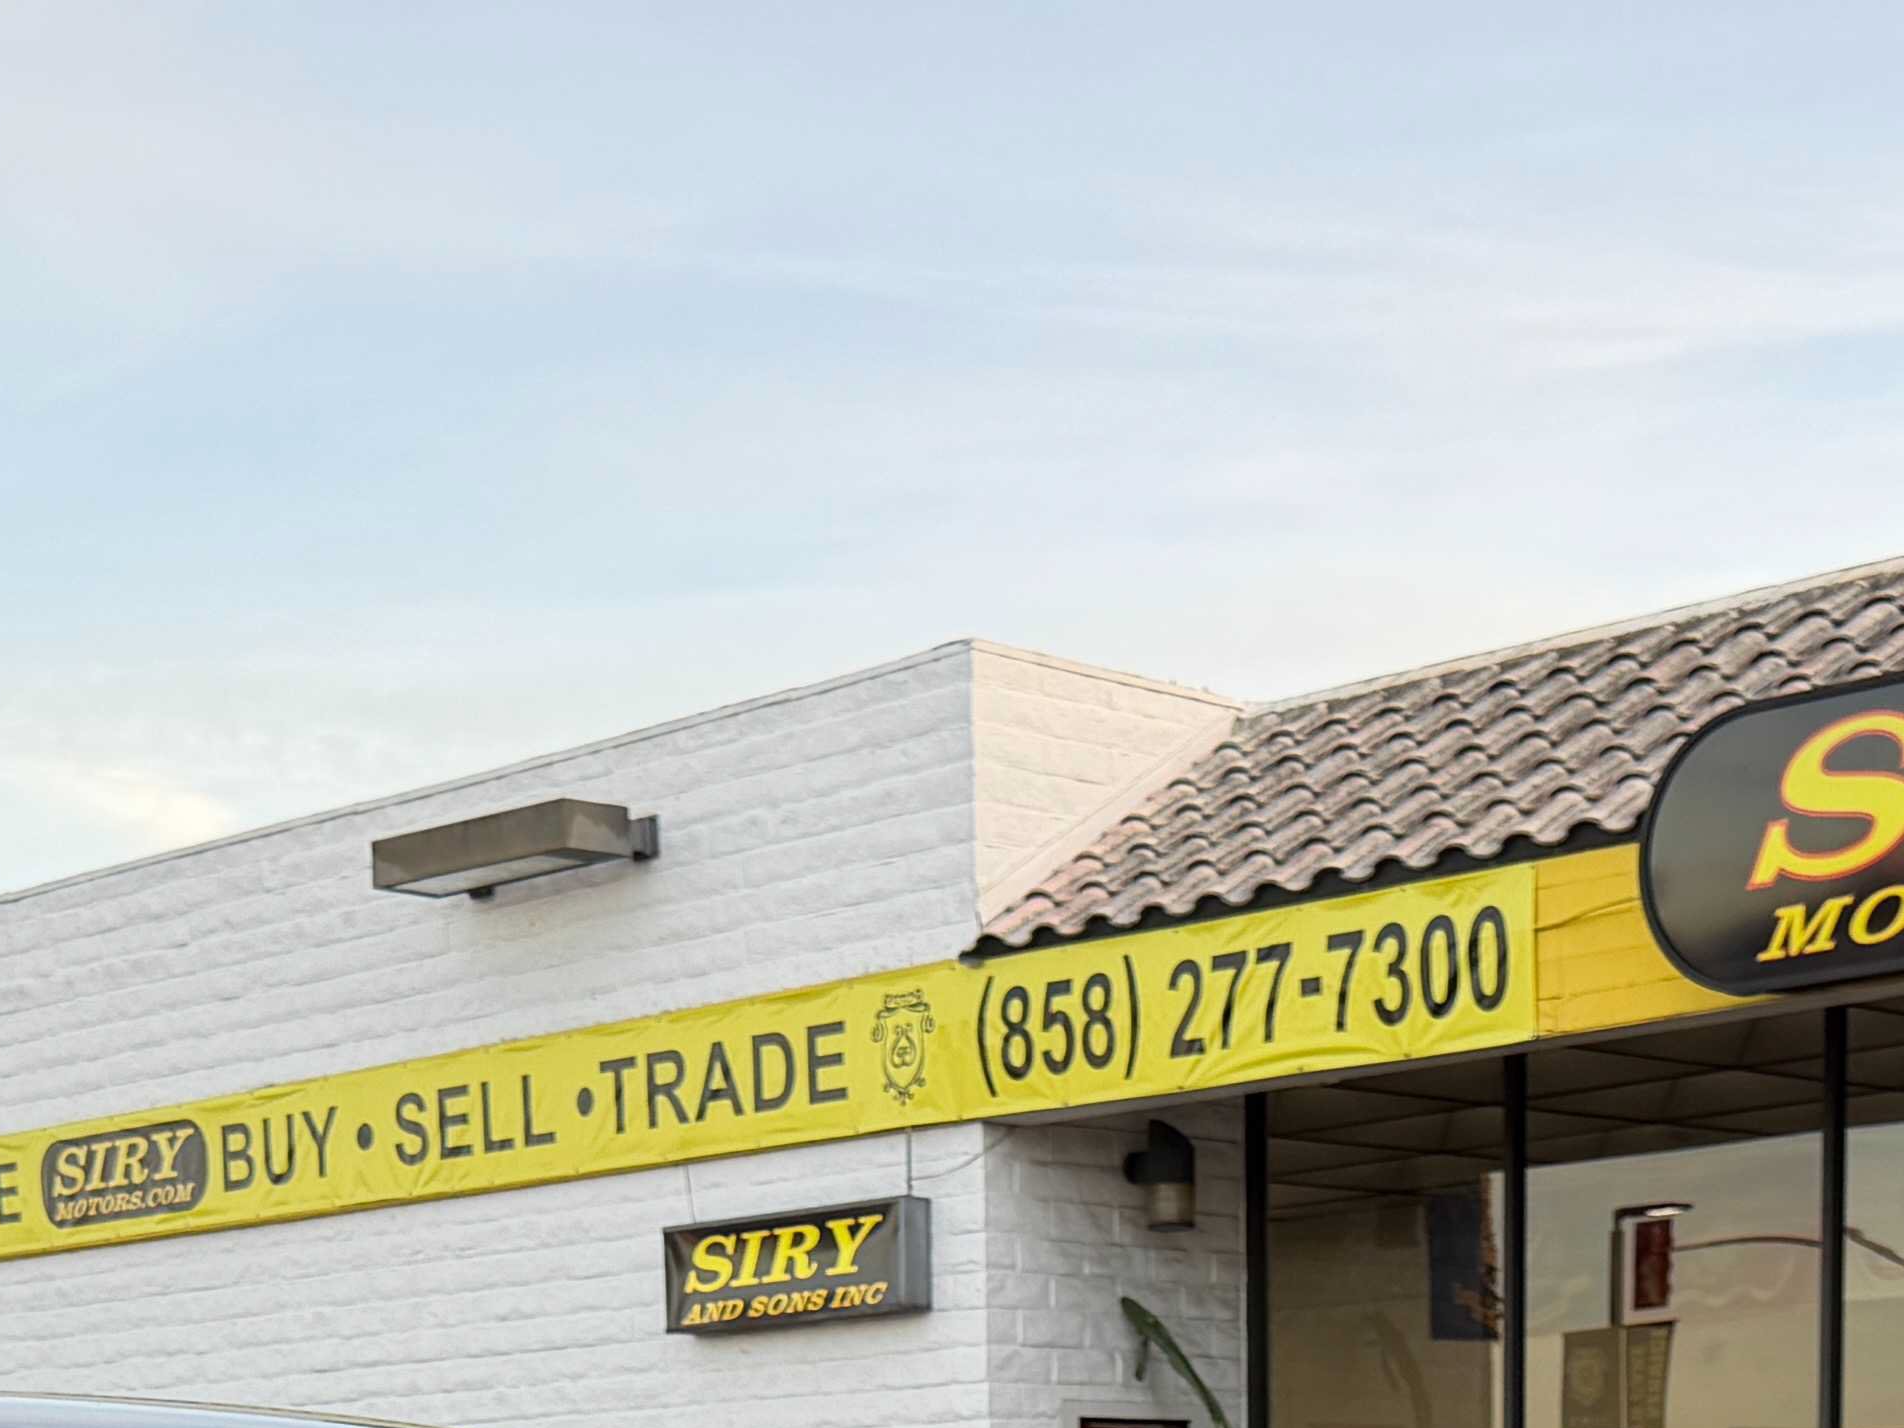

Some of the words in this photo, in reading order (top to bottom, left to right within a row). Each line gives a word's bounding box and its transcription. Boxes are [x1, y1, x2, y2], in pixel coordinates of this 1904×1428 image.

[977, 954, 1140, 1098] (858)
[1169, 905, 1507, 1059] 277-7300
[222, 1106, 338, 1191] BUY
[395, 1075, 556, 1166] SELL
[600, 1020, 850, 1135] TRADE
[51, 1120, 193, 1200] SIRY
[55, 1180, 196, 1222] MOTORS.COM
[684, 1213, 883, 1296] SIRY
[682, 1297, 744, 1327] AND
[748, 1287, 829, 1320] SONS
[832, 1280, 888, 1310] INC
